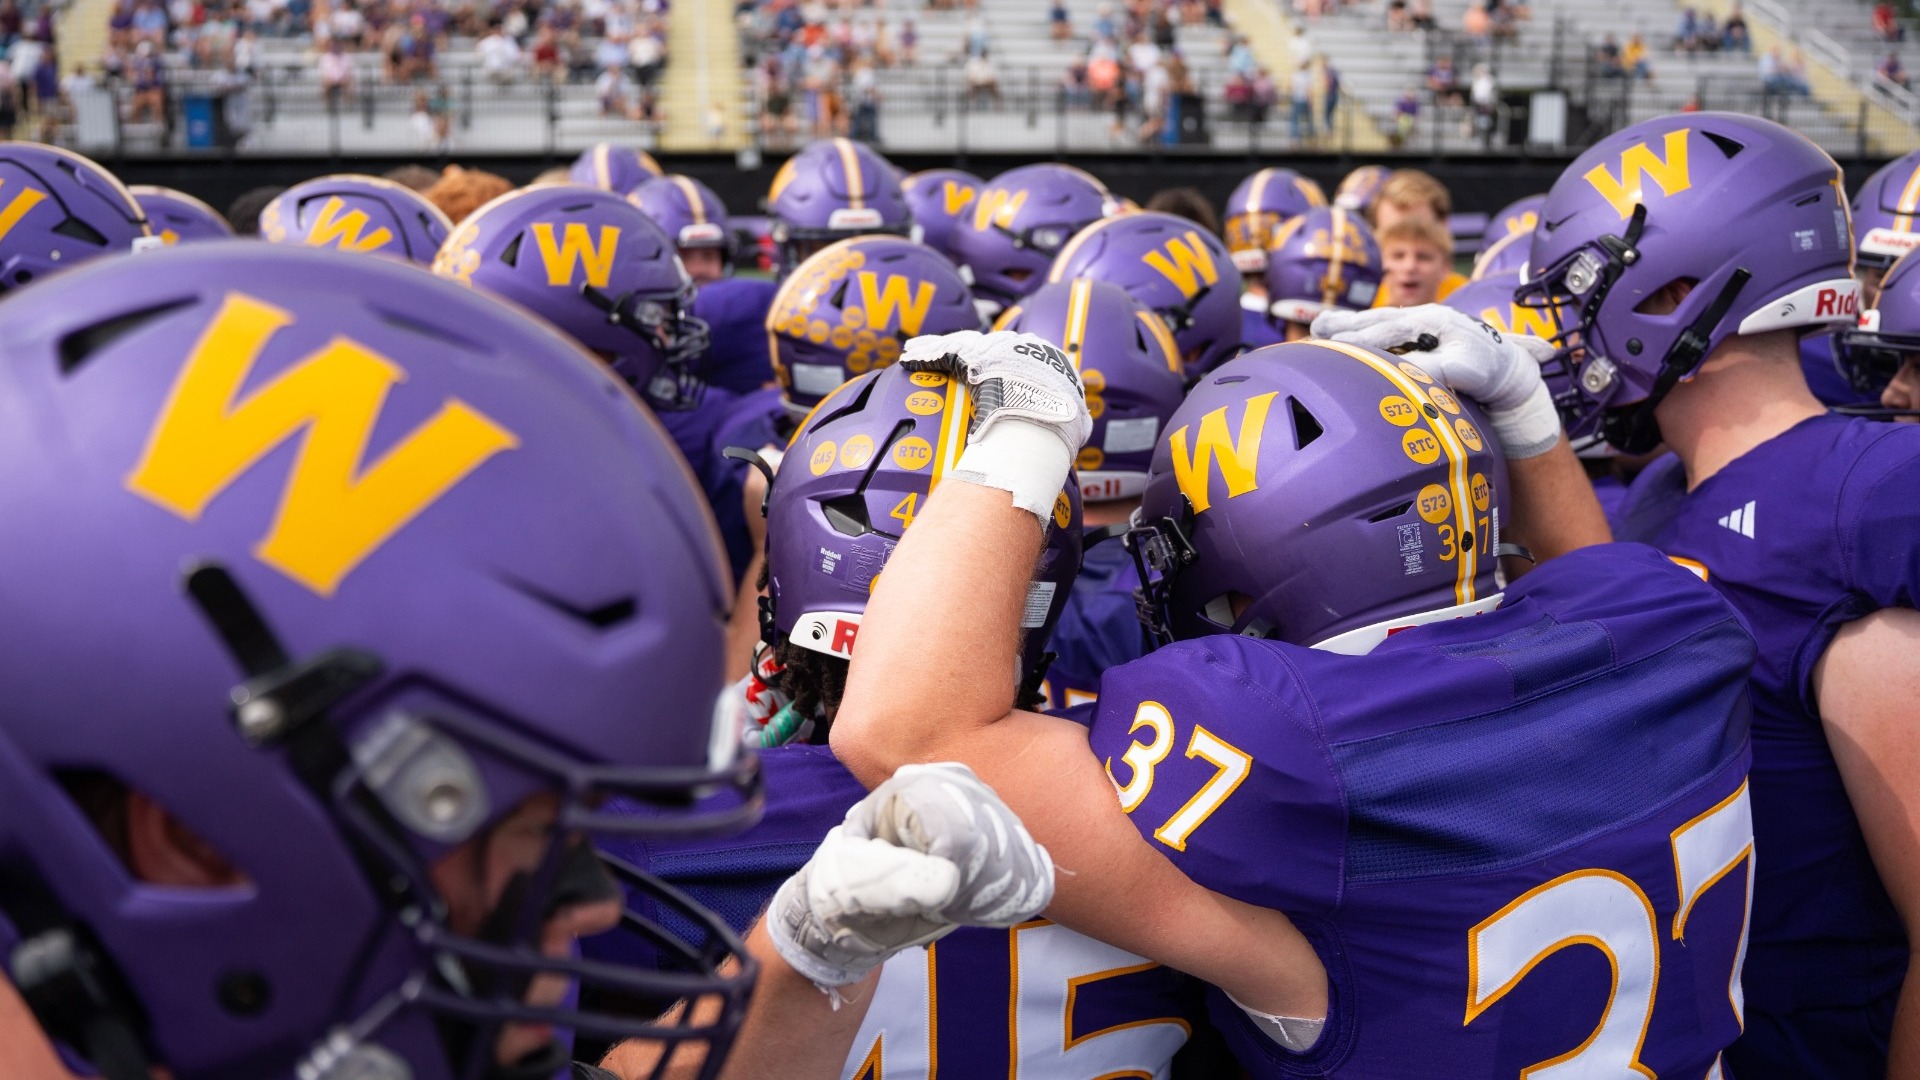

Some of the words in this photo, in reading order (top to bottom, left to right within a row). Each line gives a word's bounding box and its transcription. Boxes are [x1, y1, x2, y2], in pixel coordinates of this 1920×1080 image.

[1582, 127, 1692, 220] W
[307, 196, 393, 252] W
[973, 188, 1029, 232] W
[531, 222, 621, 288] W
[1142, 230, 1218, 298] W
[858, 271, 937, 336] W
[915, 374, 942, 382] 573
[911, 397, 939, 408] 573
[1384, 403, 1412, 417] 573
[122, 288, 521, 597] W
[813, 451, 832, 465] GAS
[898, 446, 928, 459] RTC
[1169, 391, 1279, 515] W
[1407, 437, 1435, 455] RTC
[1421, 494, 1448, 514] 573
[1473, 483, 1488, 501] RTC
[1105, 701, 1253, 852] 37
